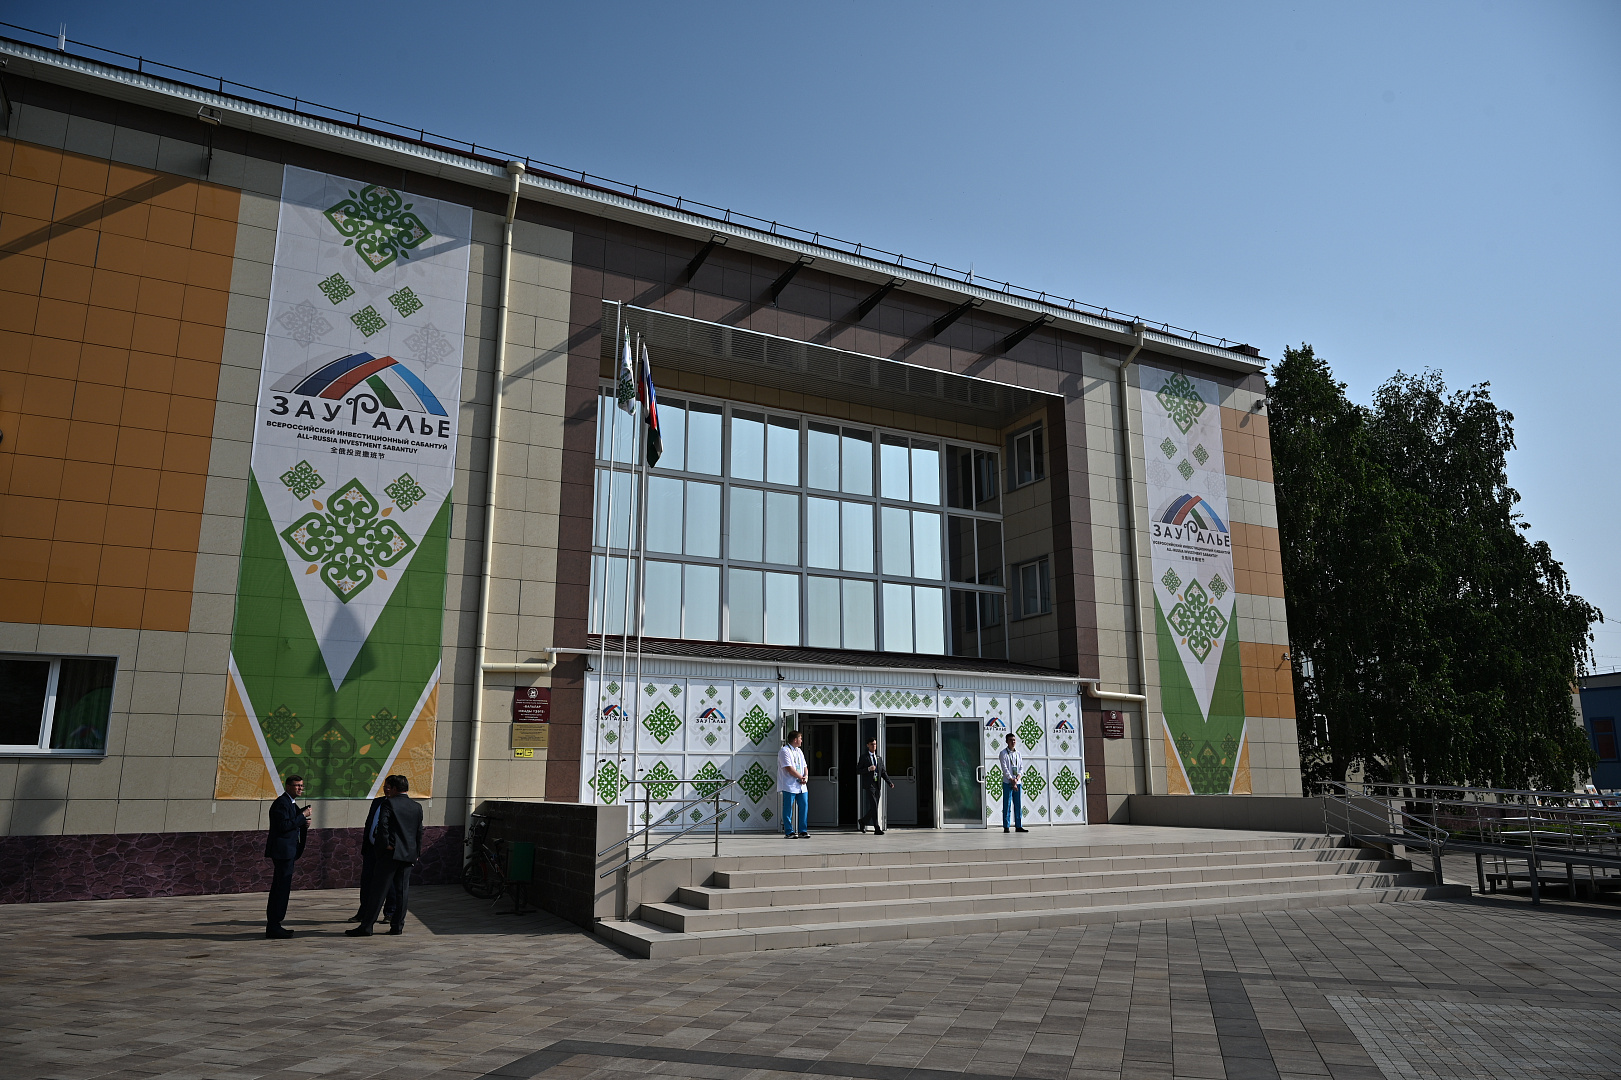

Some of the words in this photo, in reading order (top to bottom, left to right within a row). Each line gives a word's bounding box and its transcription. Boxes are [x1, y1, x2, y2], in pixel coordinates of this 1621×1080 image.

[269, 393, 450, 438] ЗАУРАЛЬЕ
[266, 420, 335, 435] ВСЕРОССИЙСКИЙ
[337, 430, 409, 445] ИНВЕСТИЦИОННЫЙ
[411, 440, 448, 450] САБАНТУЙ
[297, 433, 338, 443] ALL-RUSSIA
[339, 438, 381, 449] INVESTMENT
[382, 444, 418, 454] SABANTUY
[1153, 520, 1230, 547] ЗАУРАЛЬЕ
[695, 715, 727, 724] ЗАУРАЛЬЕ
